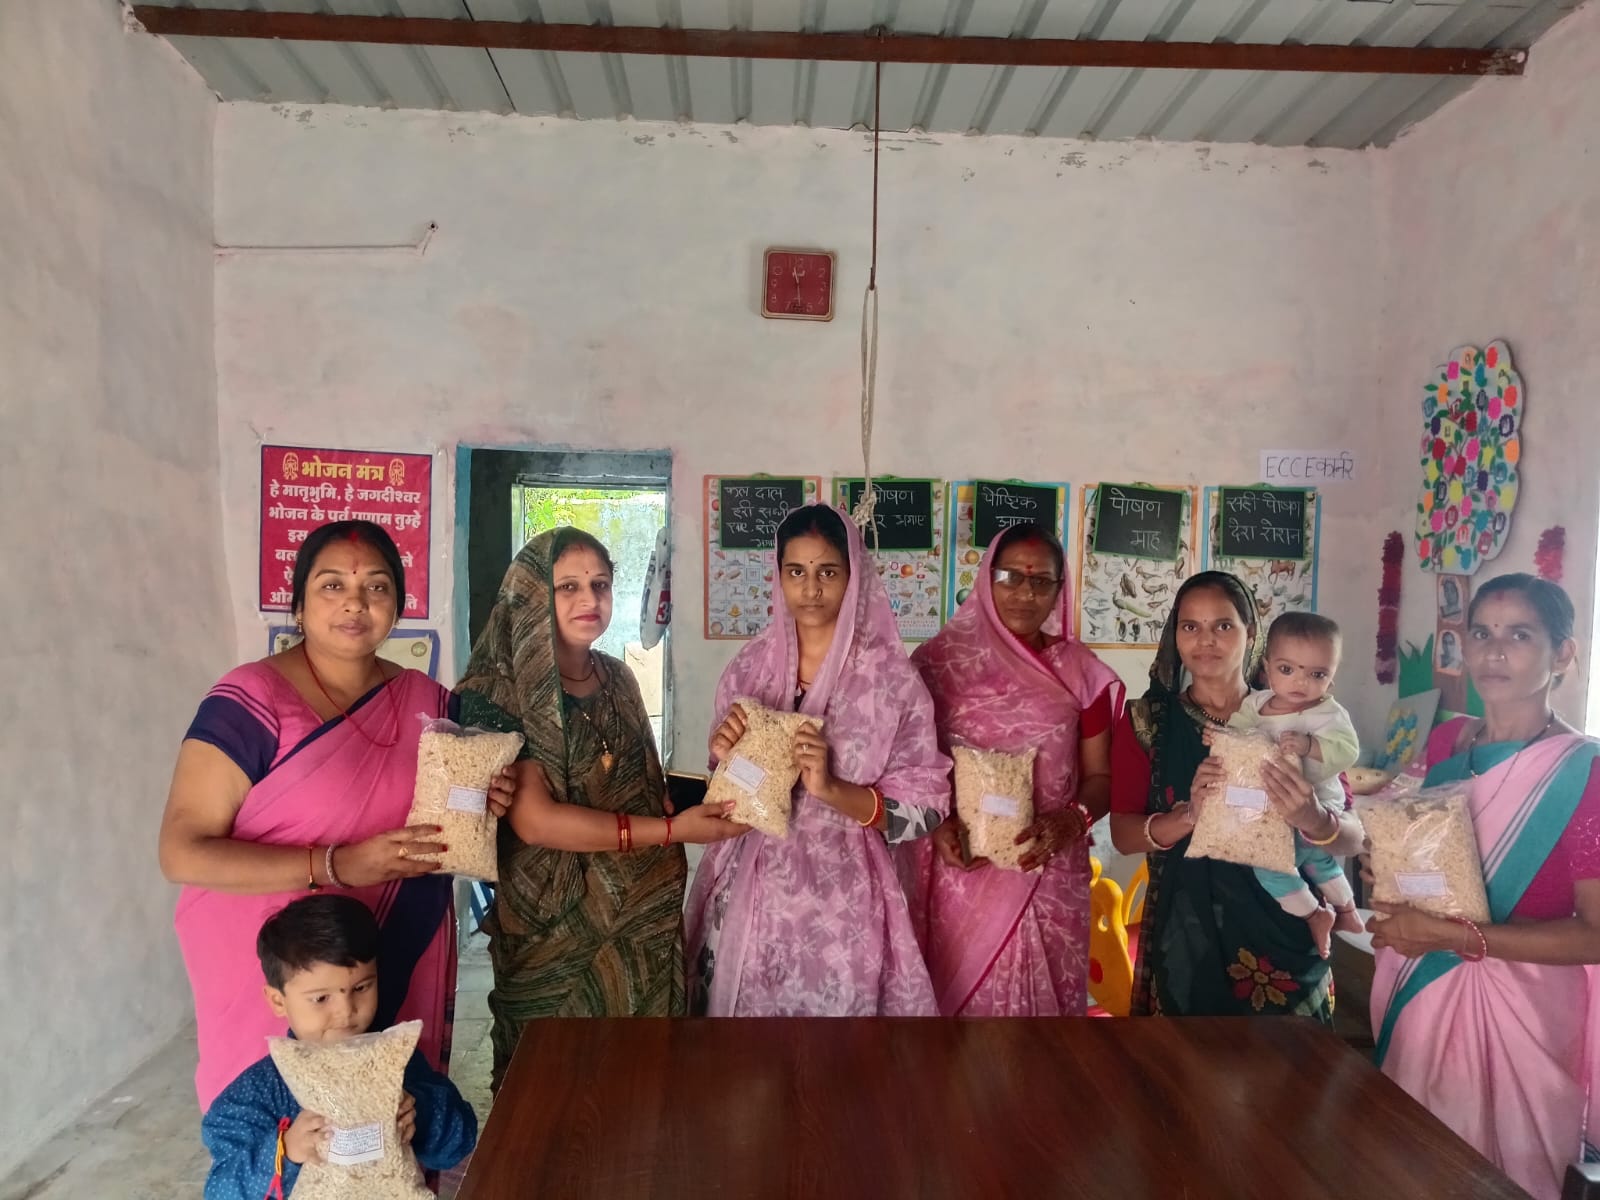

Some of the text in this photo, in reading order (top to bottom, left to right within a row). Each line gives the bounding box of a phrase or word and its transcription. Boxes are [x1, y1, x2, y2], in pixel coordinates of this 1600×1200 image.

[302, 455, 385, 481] भोजन मंत्र
[269, 479, 280, 498] हे
[344, 483, 354, 502] हे
[356, 486, 421, 504] जगदीश्वर
[754, 486, 787, 501] दाल
[268, 502, 308, 520] भोजन
[311, 504, 325, 521] के
[731, 500, 755, 519] हरी
[1108, 487, 1165, 521] पोषण
[1225, 491, 1303, 519] सही पोषण
[1129, 529, 1161, 551] माह
